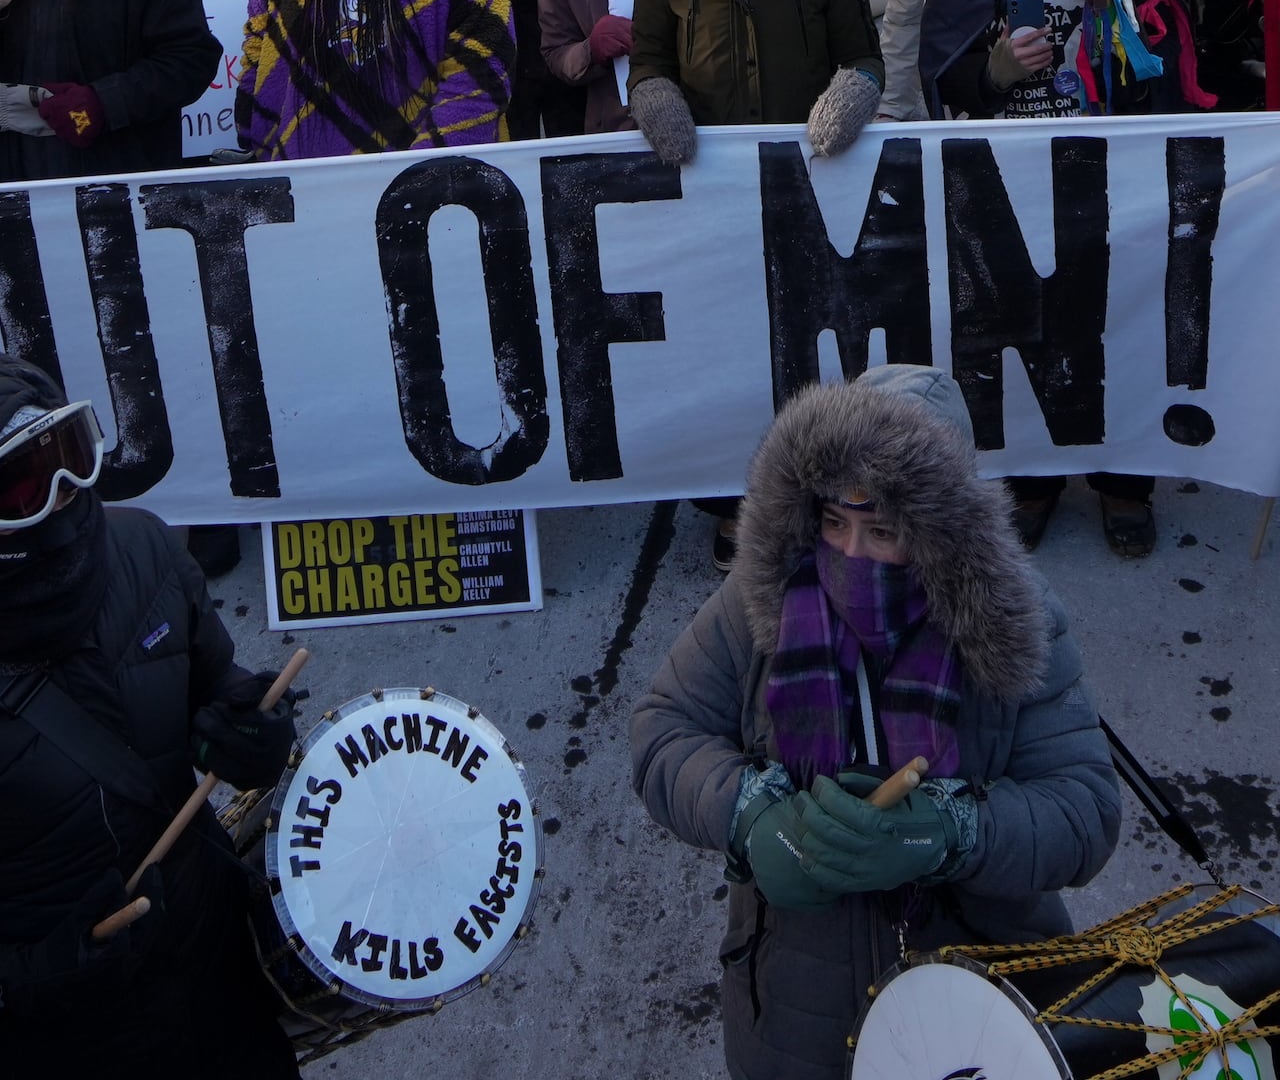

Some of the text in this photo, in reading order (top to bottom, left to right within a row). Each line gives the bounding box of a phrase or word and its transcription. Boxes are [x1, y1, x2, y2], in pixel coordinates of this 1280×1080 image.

[376, 151, 681, 486] OF
[758, 134, 1227, 450] MN!
[27, 416, 56, 435] SCOTT
[457, 520, 516, 535] ARMSTRONG
[278, 513, 458, 569] DROP THE
[459, 541, 513, 556] CHAUNTYLL
[461, 555, 489, 568] ALLEN
[281, 559, 461, 615] CHARGES
[462, 575, 504, 589] WILLIAM
[463, 588, 491, 601] KELLY
[289, 712, 492, 880] THIS MACHINE
[330, 797, 525, 982] KILLS FASCISTS
